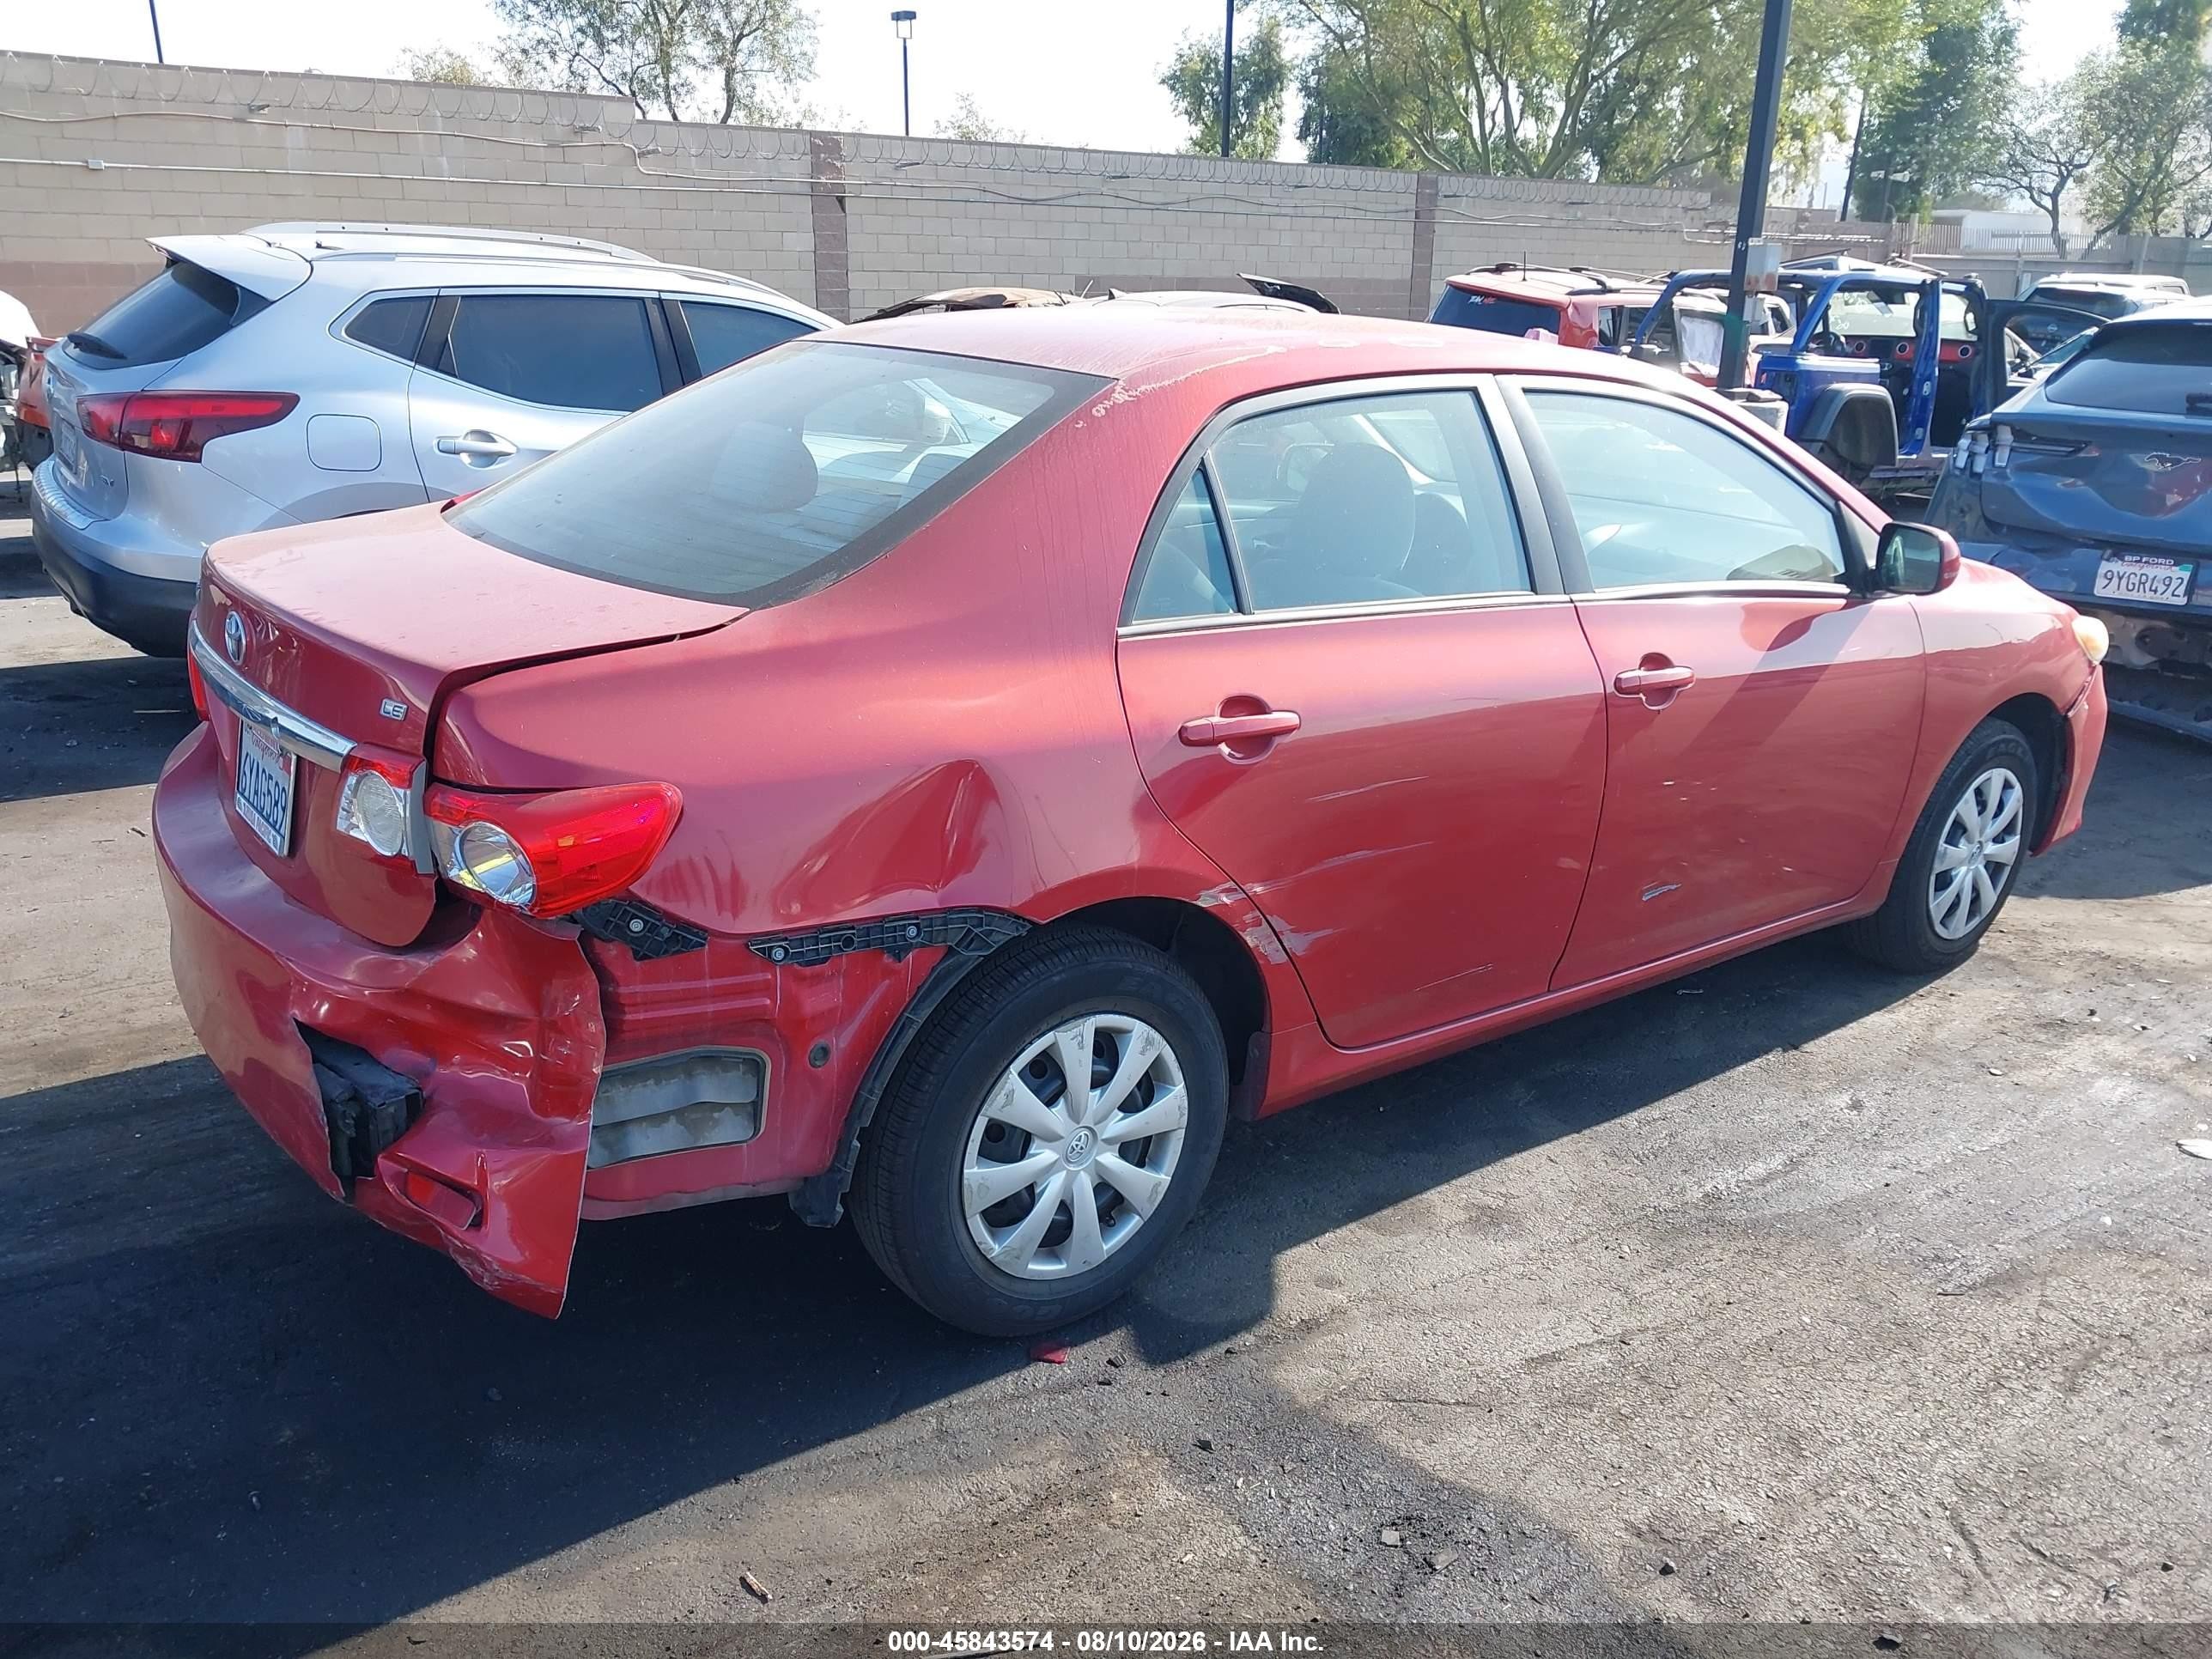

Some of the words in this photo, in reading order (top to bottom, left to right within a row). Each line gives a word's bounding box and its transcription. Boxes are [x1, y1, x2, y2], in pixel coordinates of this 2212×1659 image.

[2142, 556, 2174, 565] FORD
[2102, 569, 2185, 598] 9YGR492
[382, 700, 405, 720] LE
[240, 751, 288, 832] 6YAG589
